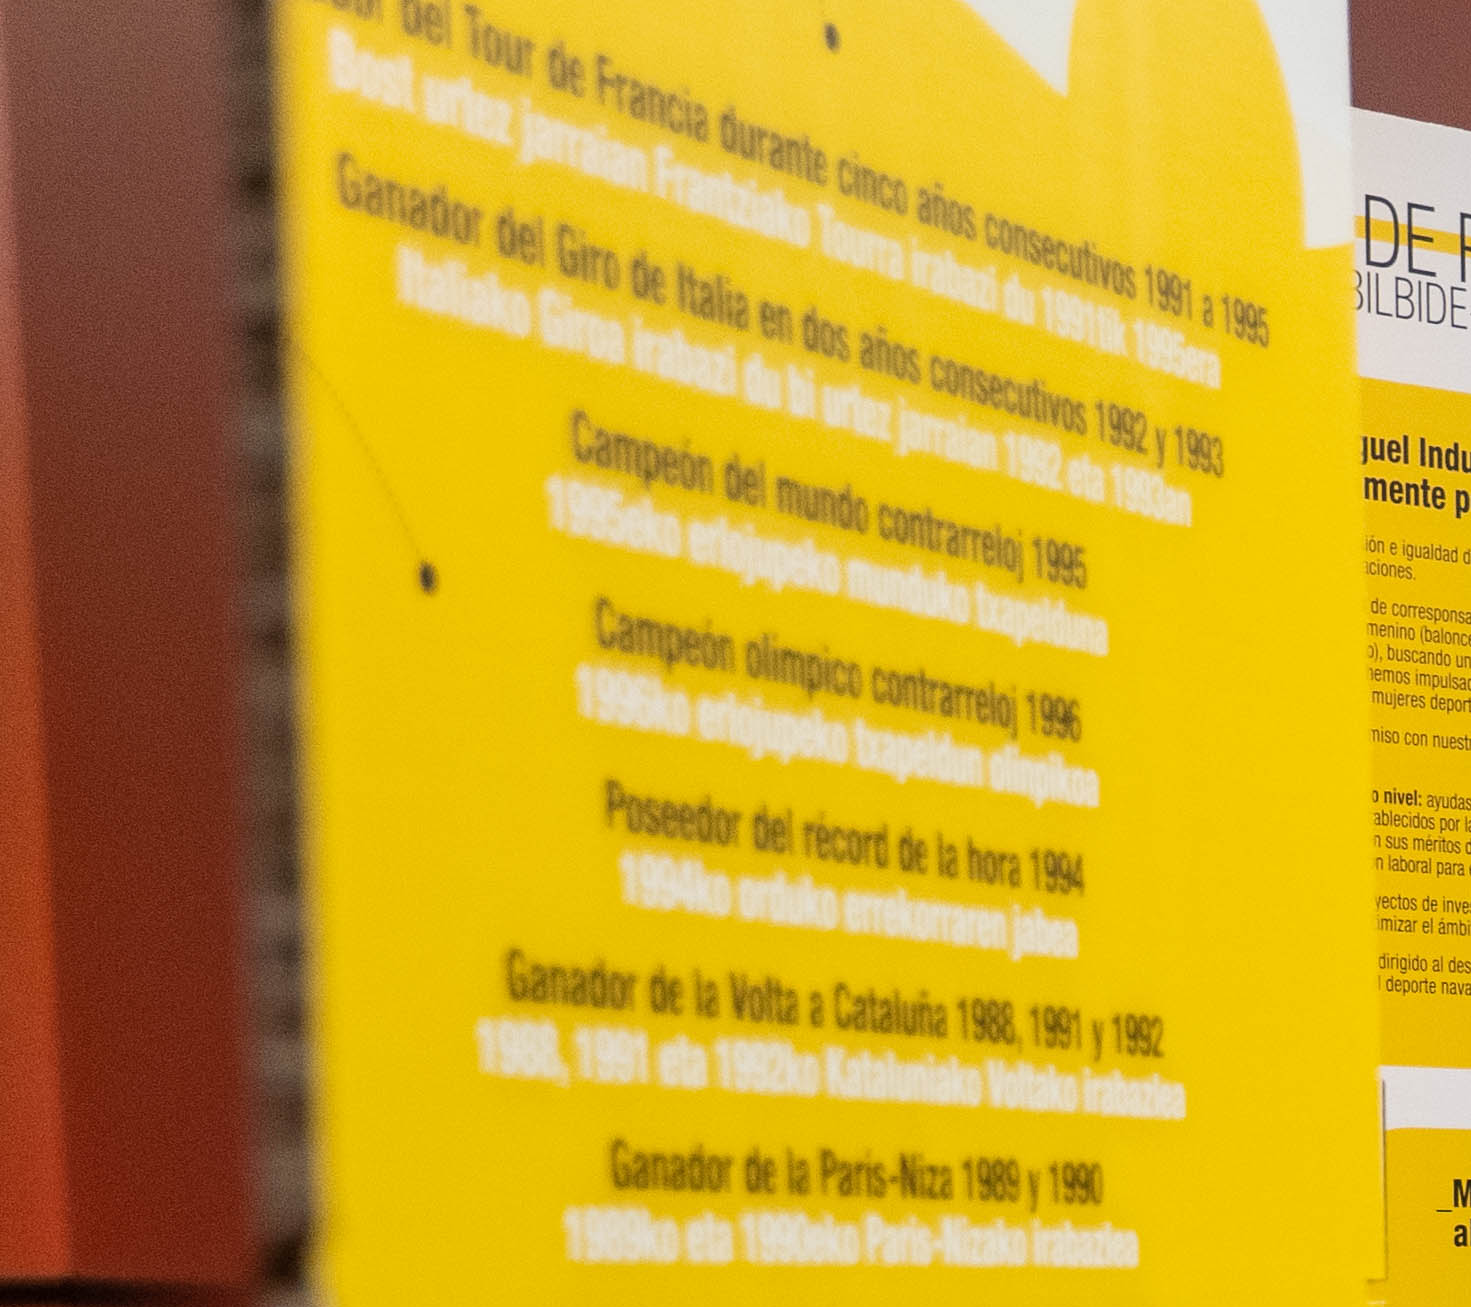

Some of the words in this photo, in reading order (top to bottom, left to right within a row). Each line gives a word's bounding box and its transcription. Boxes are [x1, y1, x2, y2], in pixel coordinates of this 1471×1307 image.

[1365, 194, 1435, 277] DE
[569, 408, 716, 489] Campeón
[721, 449, 768, 504] del
[773, 475, 871, 531] mundo
[875, 502, 1025, 584] contrarreloj
[1031, 533, 1089, 590] 1995
[1369, 597, 1389, 615] de
[1386, 644, 1452, 668] buscando
[1371, 689, 1426, 711] mujeres
[600, 780, 743, 846] Poseedor
[749, 803, 795, 853] del
[800, 812, 891, 867] récord
[895, 825, 930, 873] de
[935, 831, 961, 877] la
[964, 836, 1023, 886] hora
[1029, 845, 1087, 896] 1994
[1388, 855, 1432, 874] laboral
[1436, 862, 1466, 880] para
[1378, 953, 1428, 975] dirigido
[1430, 956, 1445, 973] al
